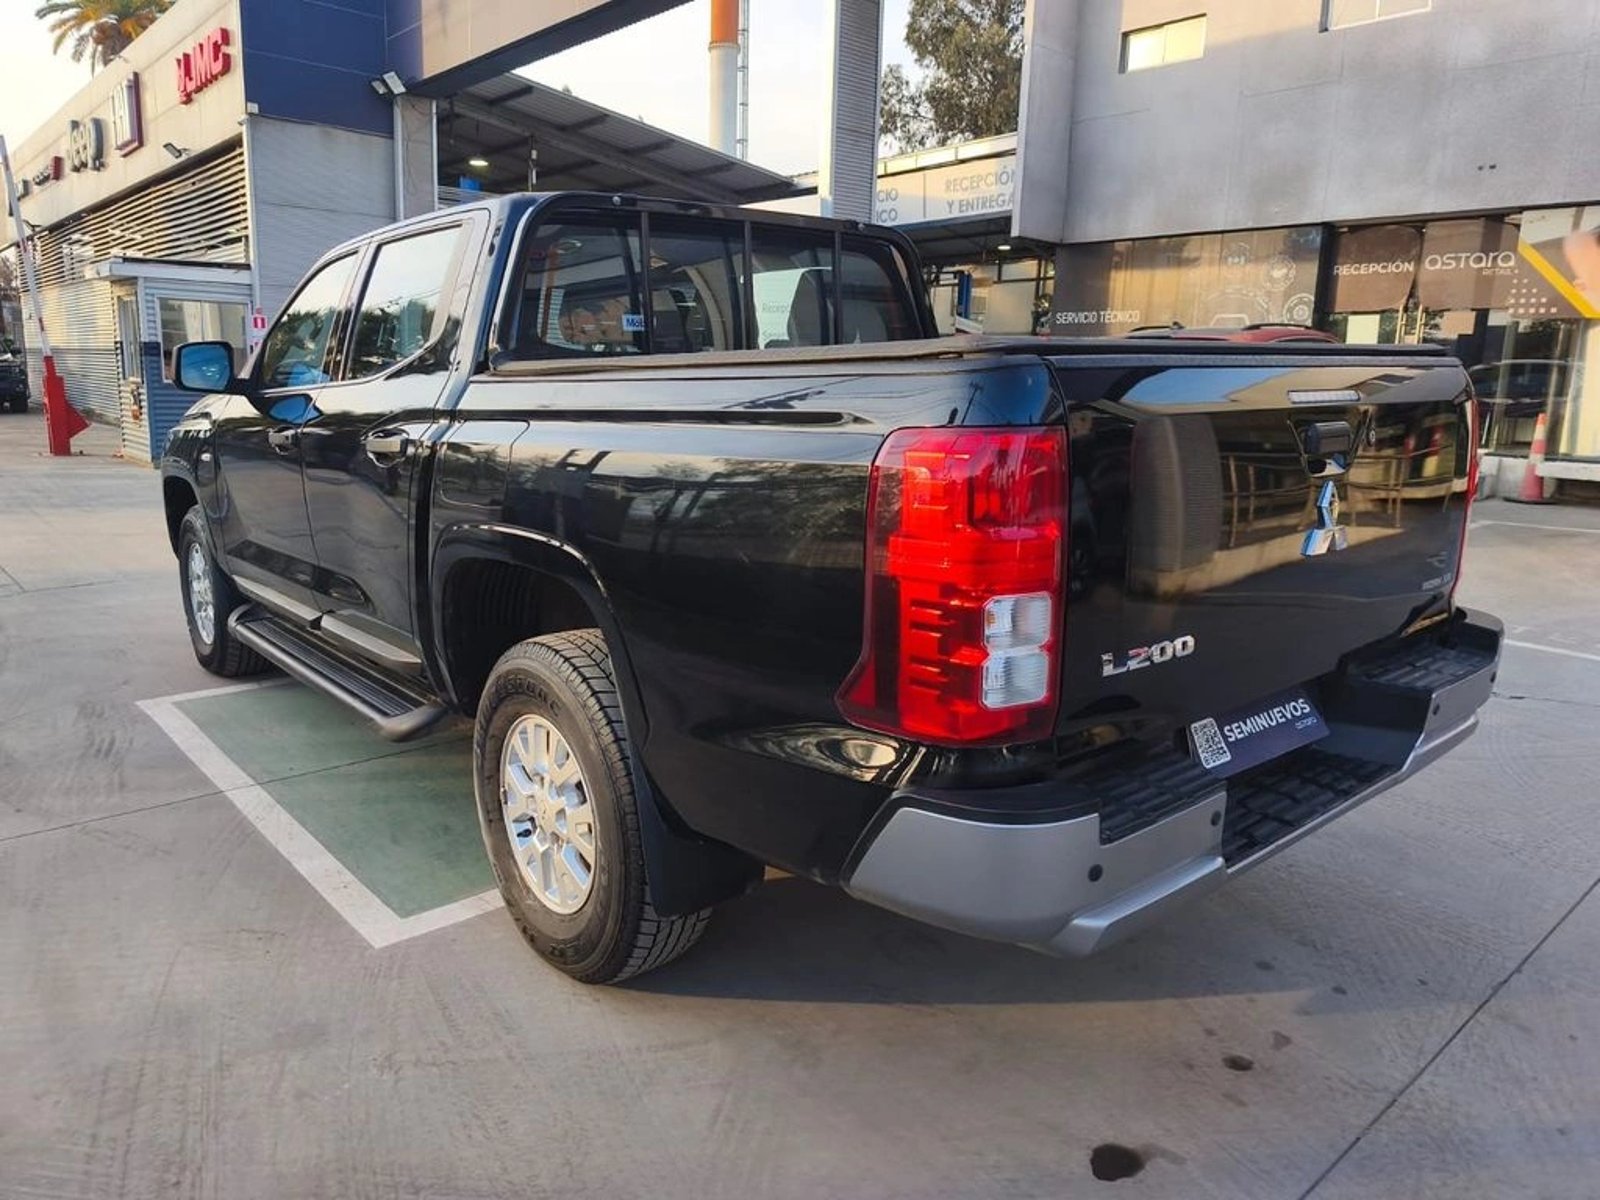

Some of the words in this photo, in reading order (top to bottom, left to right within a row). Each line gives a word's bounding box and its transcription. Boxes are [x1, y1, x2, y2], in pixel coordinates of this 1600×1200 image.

[184, 27, 231, 96] JMC
[946, 201, 954, 214] Y
[1334, 259, 1415, 276] RECEPCIÓN
[1056, 312, 1098, 324] SERVICIO
[1099, 308, 1140, 324] TÉCNICO
[1101, 635, 1196, 677] L200
[1223, 698, 1311, 742] SEMINUEVOS
